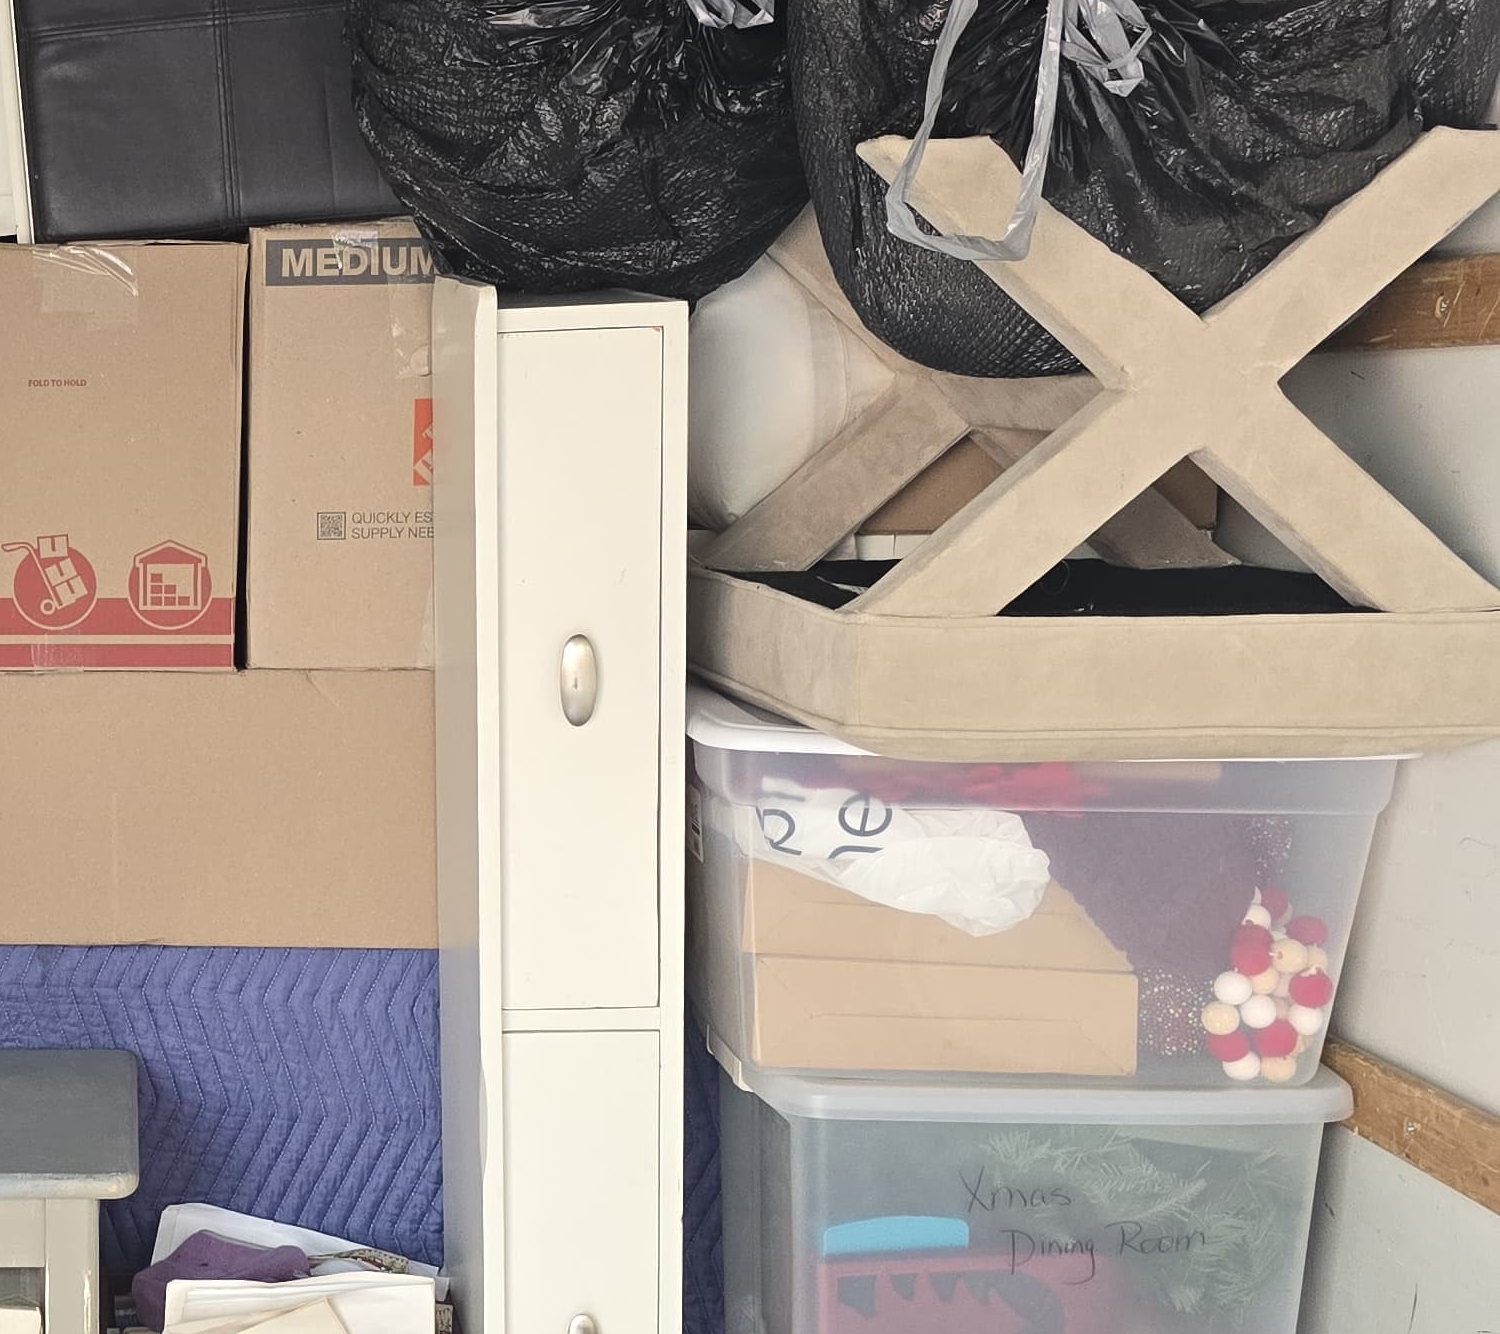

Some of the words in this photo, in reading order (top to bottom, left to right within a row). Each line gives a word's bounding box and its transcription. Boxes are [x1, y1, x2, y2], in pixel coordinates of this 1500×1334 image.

[281, 246, 437, 278] MEDIUM
[28, 378, 50, 387] FOLD
[51, 378, 63, 387] TO
[63, 378, 87, 387] HOLD
[351, 511, 411, 524] QUICKLY
[351, 527, 404, 539] SUPPLY
[958, 1165, 1072, 1213] Xmas
[1000, 1229, 1097, 1286] Dining
[1104, 1220, 1208, 1256] Room
